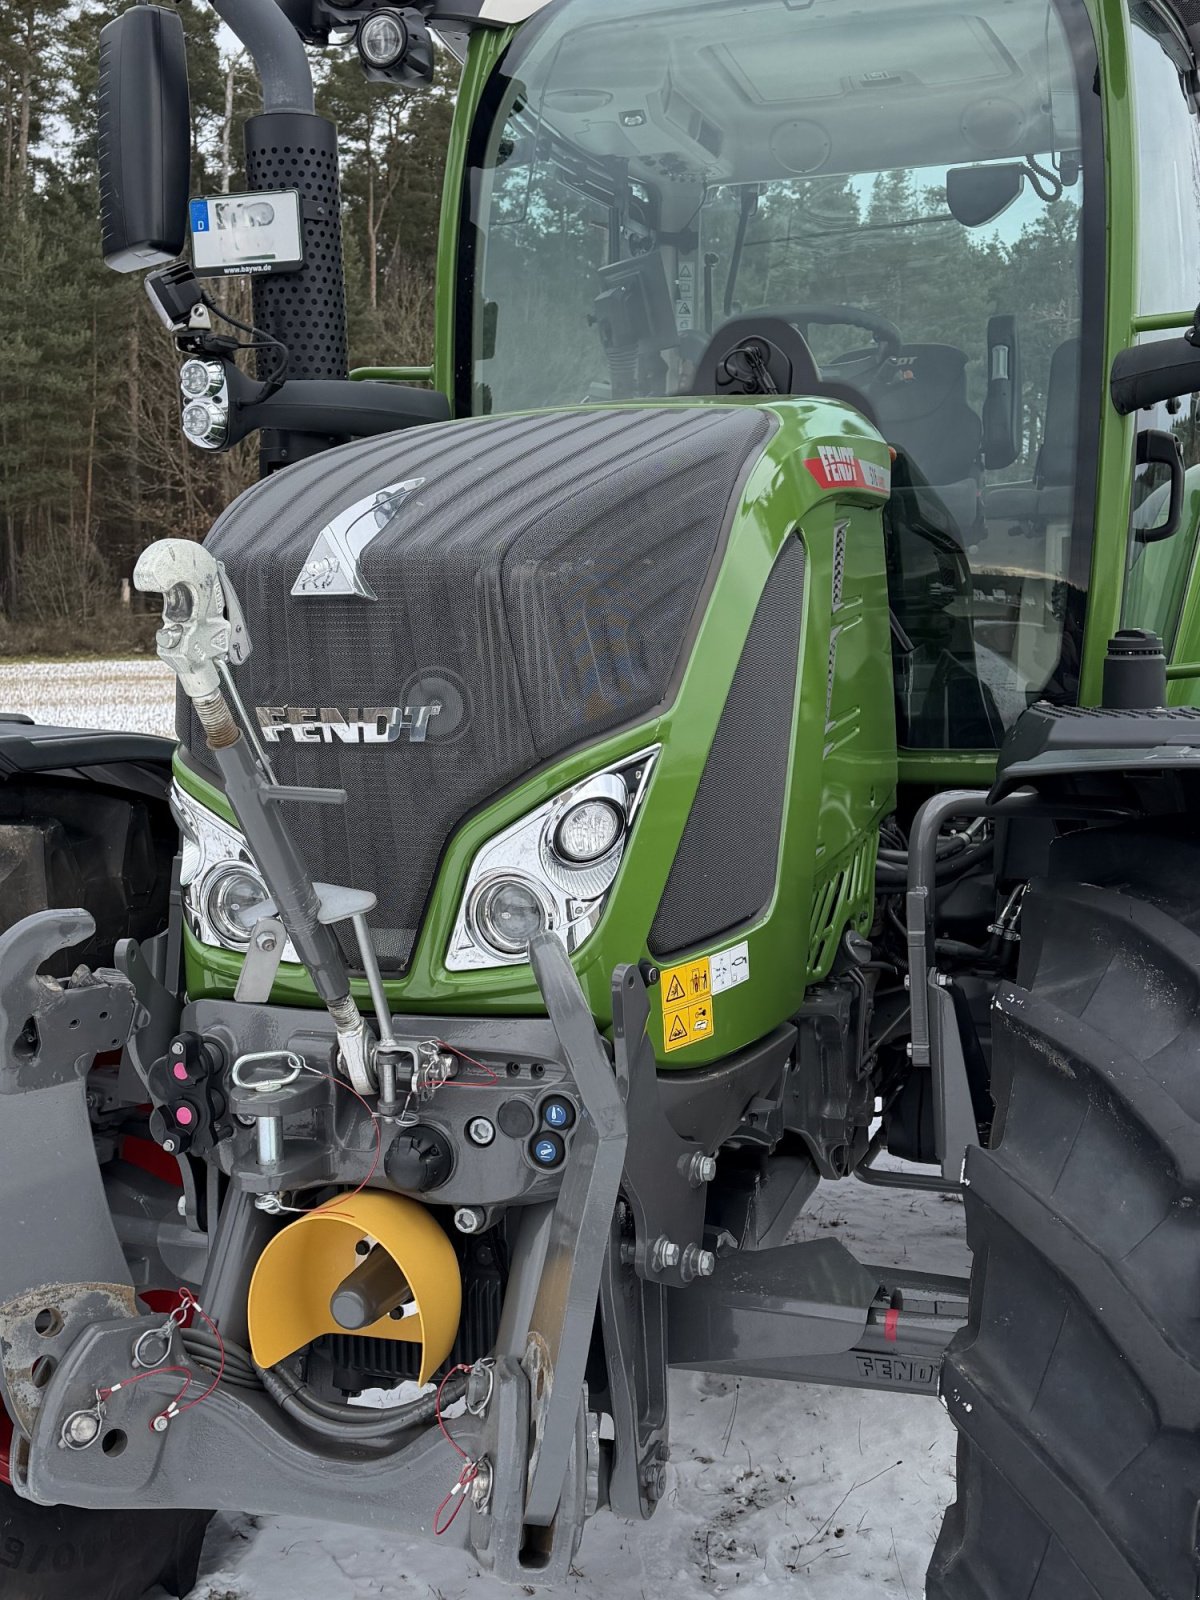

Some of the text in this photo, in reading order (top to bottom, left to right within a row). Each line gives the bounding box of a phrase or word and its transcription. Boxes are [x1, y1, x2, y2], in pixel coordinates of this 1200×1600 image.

[198, 221, 205, 230] D
[223, 264, 272, 274] www.baywa.de
[255, 704, 434, 743] FENDT
